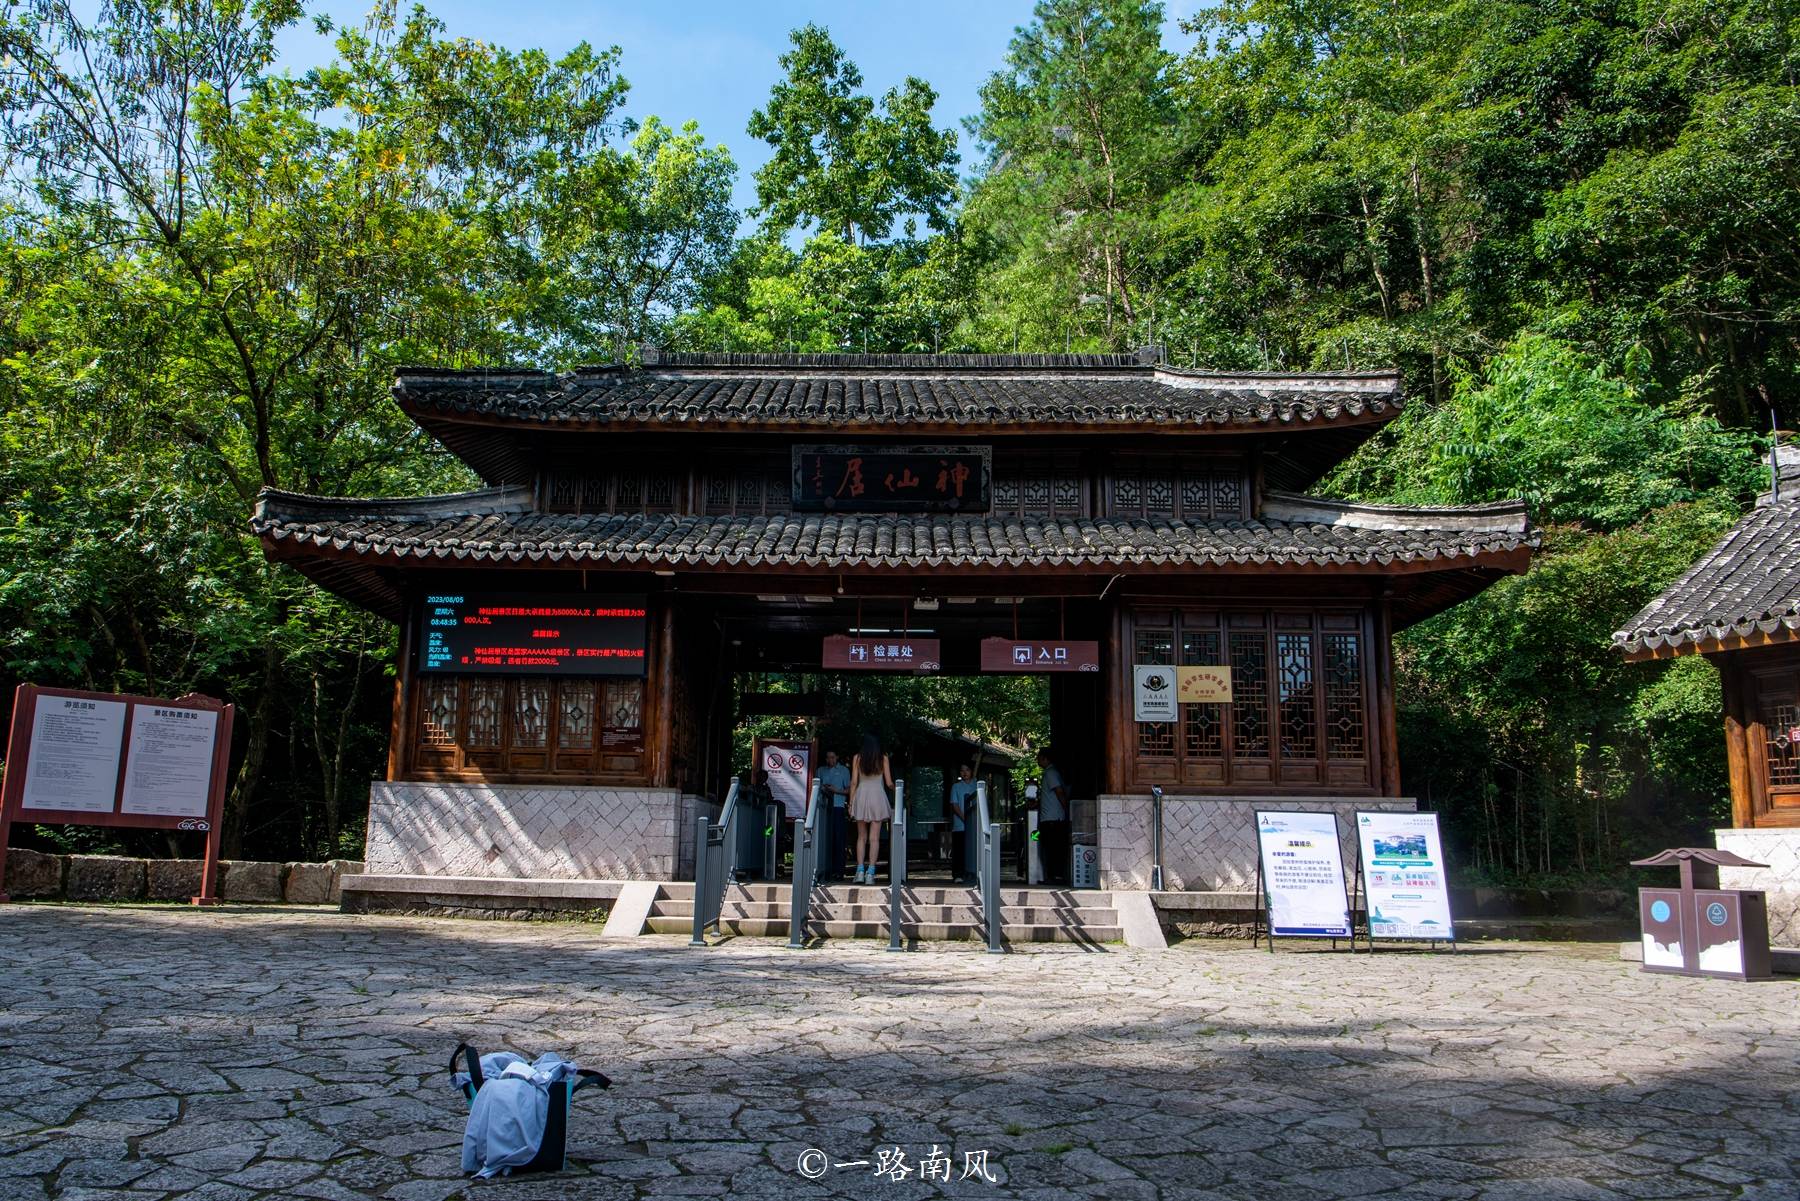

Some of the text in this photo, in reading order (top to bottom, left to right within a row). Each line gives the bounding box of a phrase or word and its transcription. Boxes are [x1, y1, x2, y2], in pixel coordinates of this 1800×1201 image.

[873, 645, 913, 658] 检票处
[1038, 647, 1067, 659] 入口
